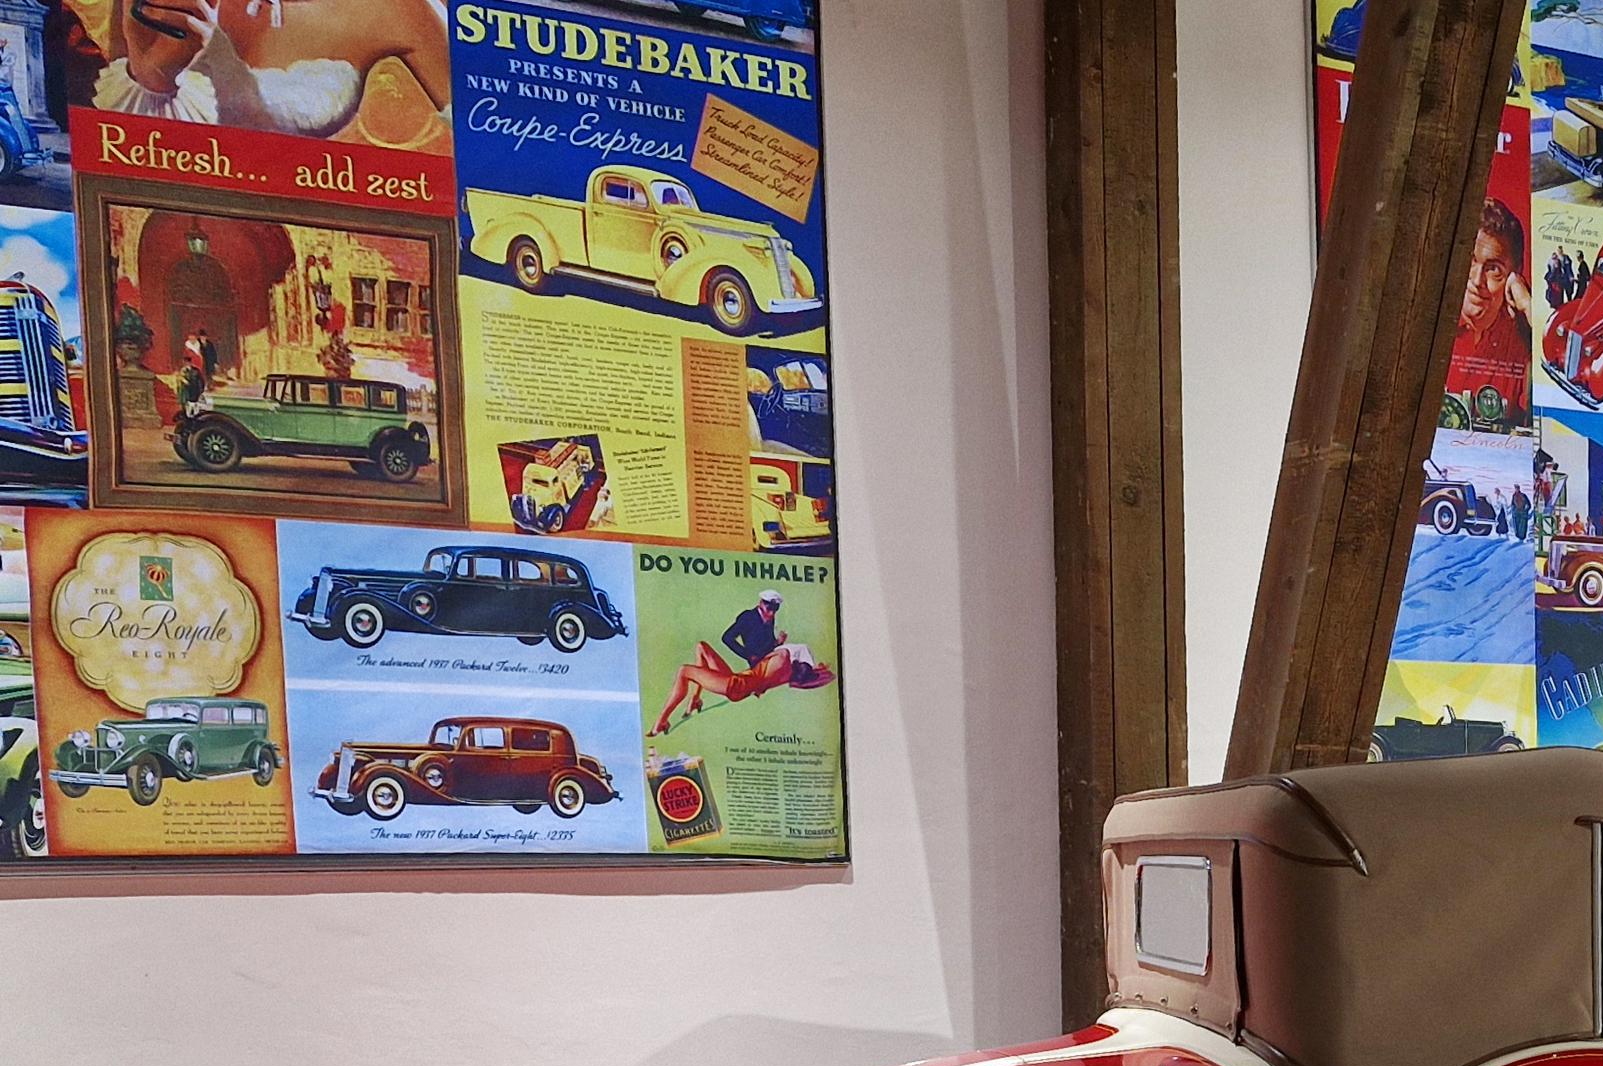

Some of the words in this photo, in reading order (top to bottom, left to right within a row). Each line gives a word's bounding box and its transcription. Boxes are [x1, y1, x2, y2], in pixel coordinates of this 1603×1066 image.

[456, 4, 812, 100] STUDEBAKER
[509, 59, 618, 89] PRESENTS
[629, 79, 643, 94] A
[466, 74, 512, 93] NEW
[518, 82, 568, 103] KIND
[576, 92, 600, 108] OF
[606, 96, 686, 122] VEHICLE
[467, 97, 687, 162] Coupe-Express
[709, 107, 741, 130] Truck
[740, 125, 767, 144] Load
[767, 138, 815, 168] Capacity!
[98, 123, 268, 182] Refresh...
[295, 153, 357, 193] add
[366, 173, 433, 201] zest
[704, 126, 750, 156] Passenger
[752, 150, 767, 165] Car
[769, 160, 811, 186] Comfort!
[700, 143, 769, 184] Streamlined
[767, 178, 805, 202] Style!
[504, 415, 556, 428] STUDEBAKER
[1451, 431, 1525, 449] Lincoln
[640, 553, 672, 573] DO
[679, 557, 725, 577] YOU
[734, 560, 829, 584] INHALE?
[94, 587, 116, 595] THE
[69, 601, 233, 651] Reo-Royale
[132, 651, 189, 660] EIGHT
[356, 654, 378, 667] The
[379, 657, 427, 669] advanced
[451, 660, 493, 672] Packard
[661, 783, 693, 801] LUCKY
[663, 795, 700, 811] STRIKE
[370, 827, 391, 840] The
[437, 830, 481, 841] Packard
[664, 818, 716, 840] CIGARETTES
